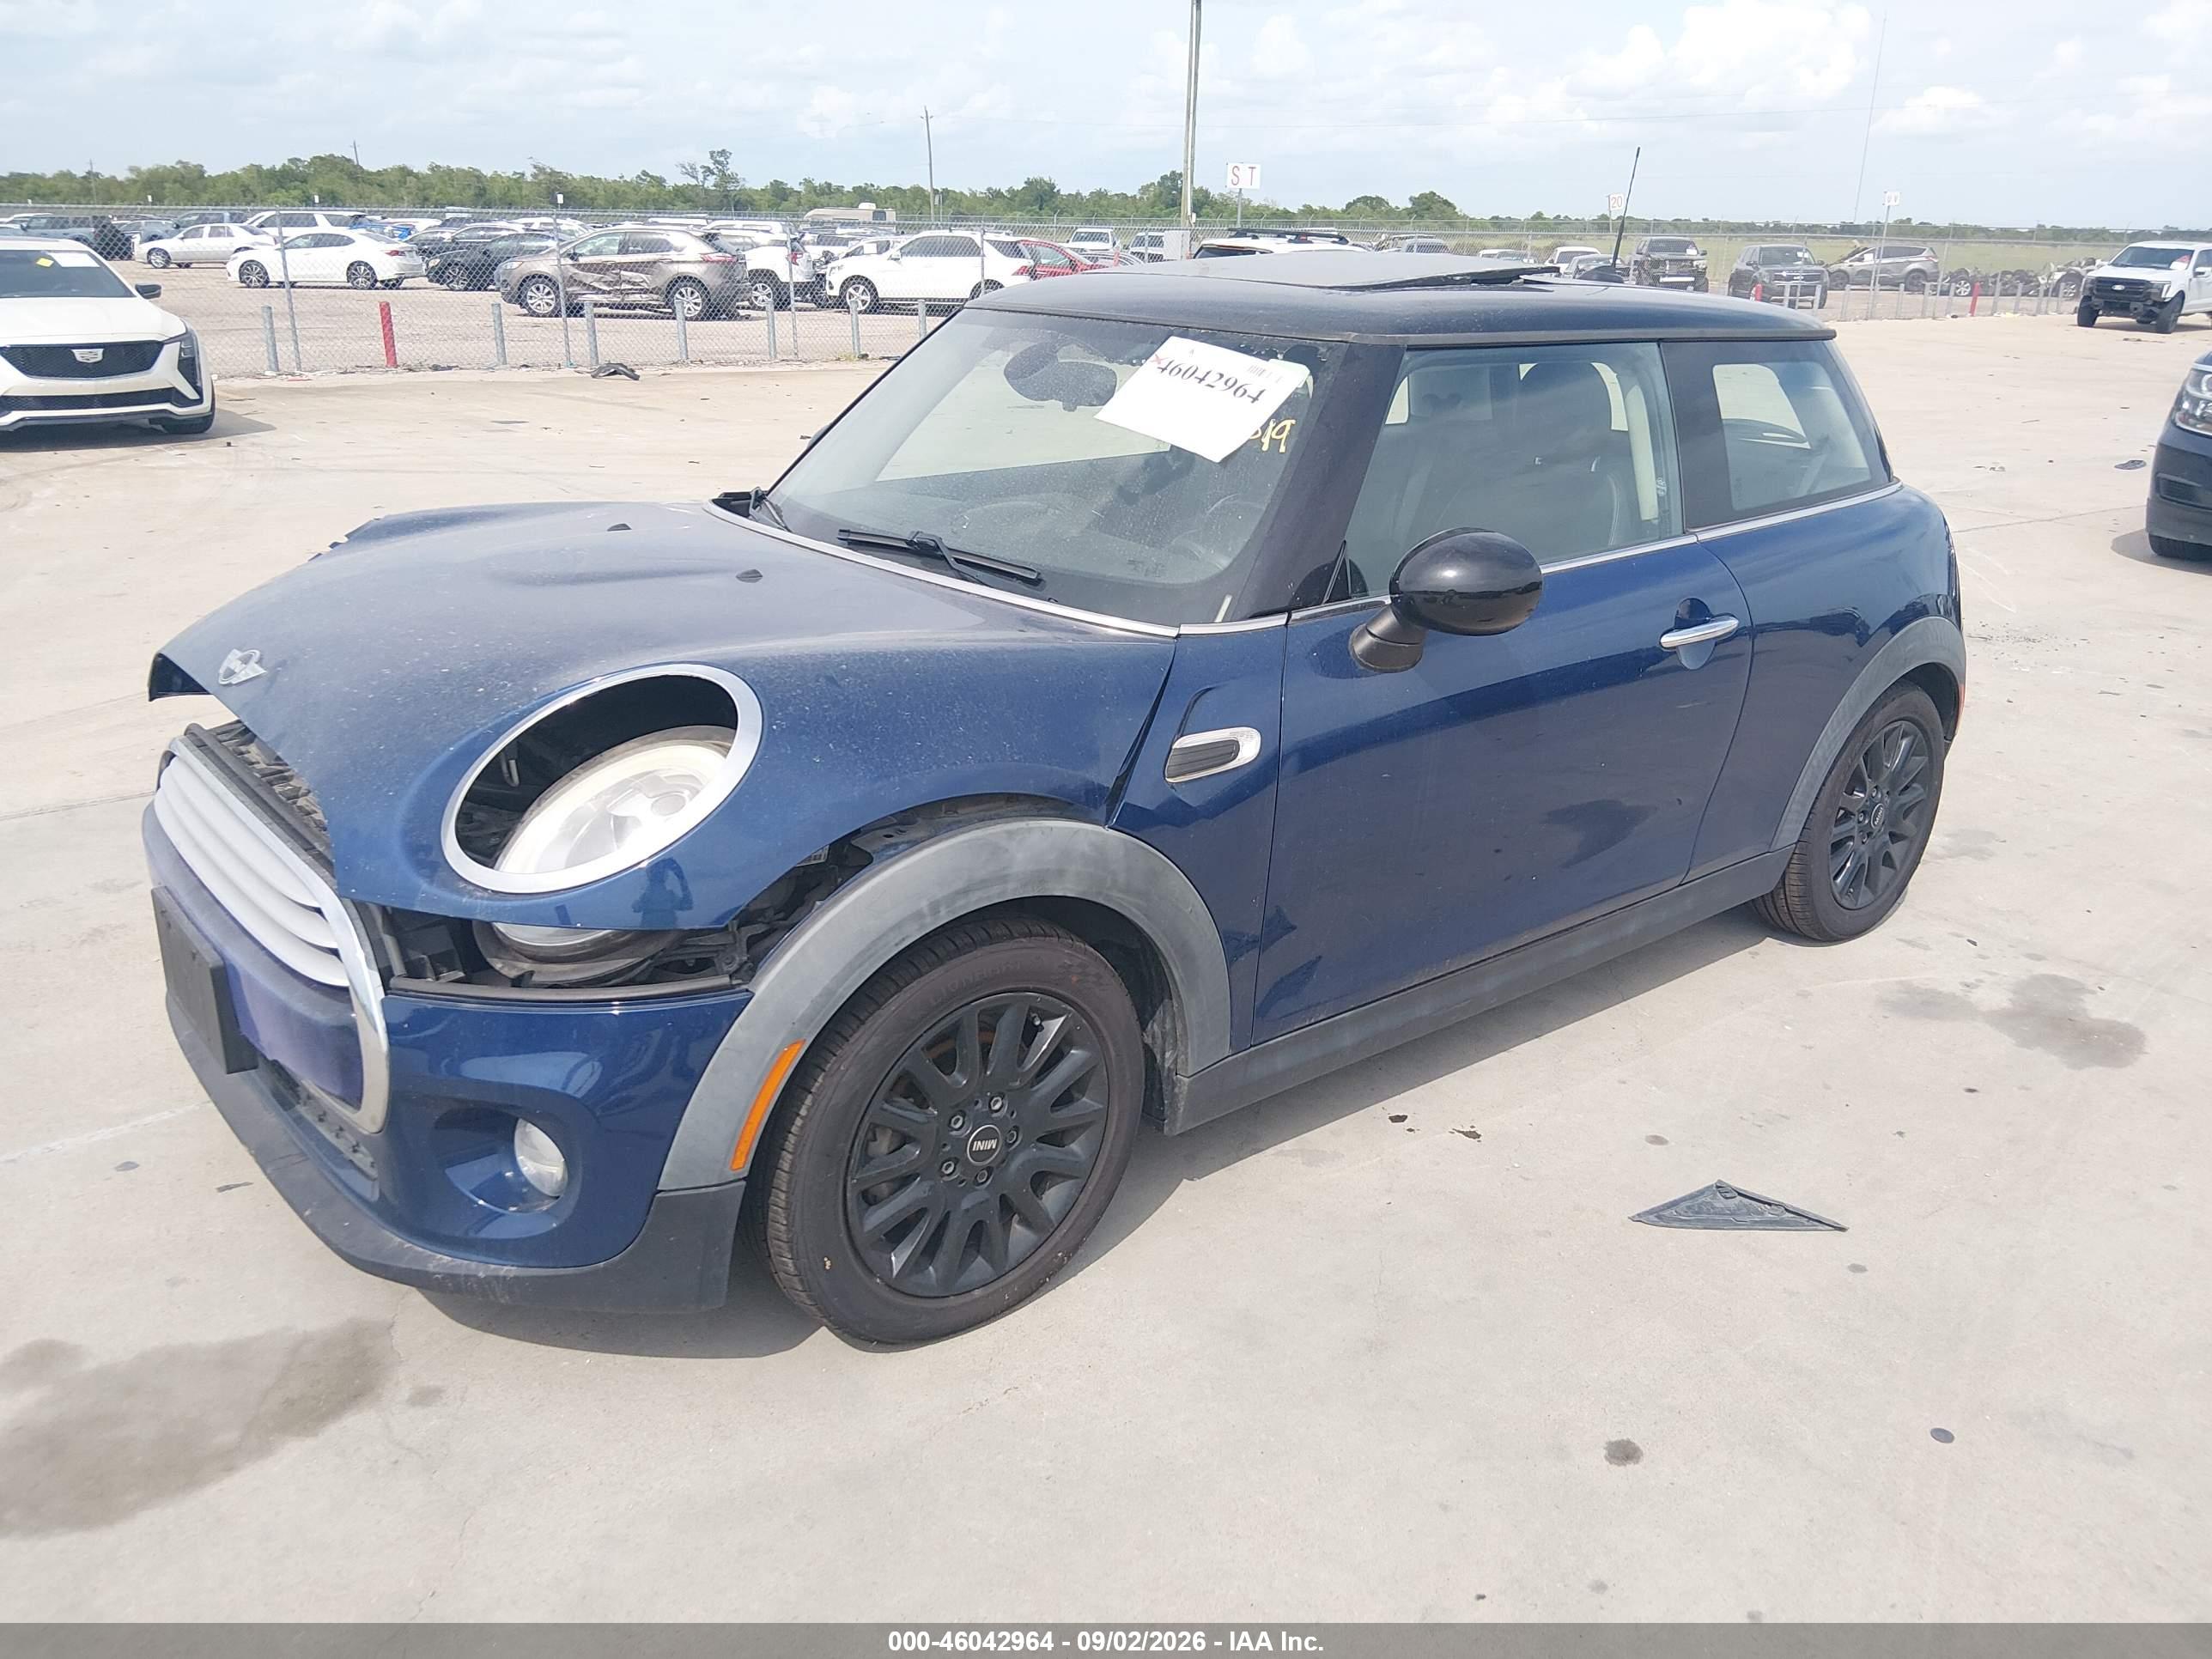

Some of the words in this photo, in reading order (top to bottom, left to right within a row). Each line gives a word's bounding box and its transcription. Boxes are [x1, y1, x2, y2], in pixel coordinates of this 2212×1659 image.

[1231, 166, 1240, 185] S
[1248, 167, 1256, 185] T
[1612, 196, 1622, 208] 20
[1157, 359, 1267, 404] 46042964
[1875, 806, 1884, 825] MINI
[972, 1139, 998, 1152] MINI
